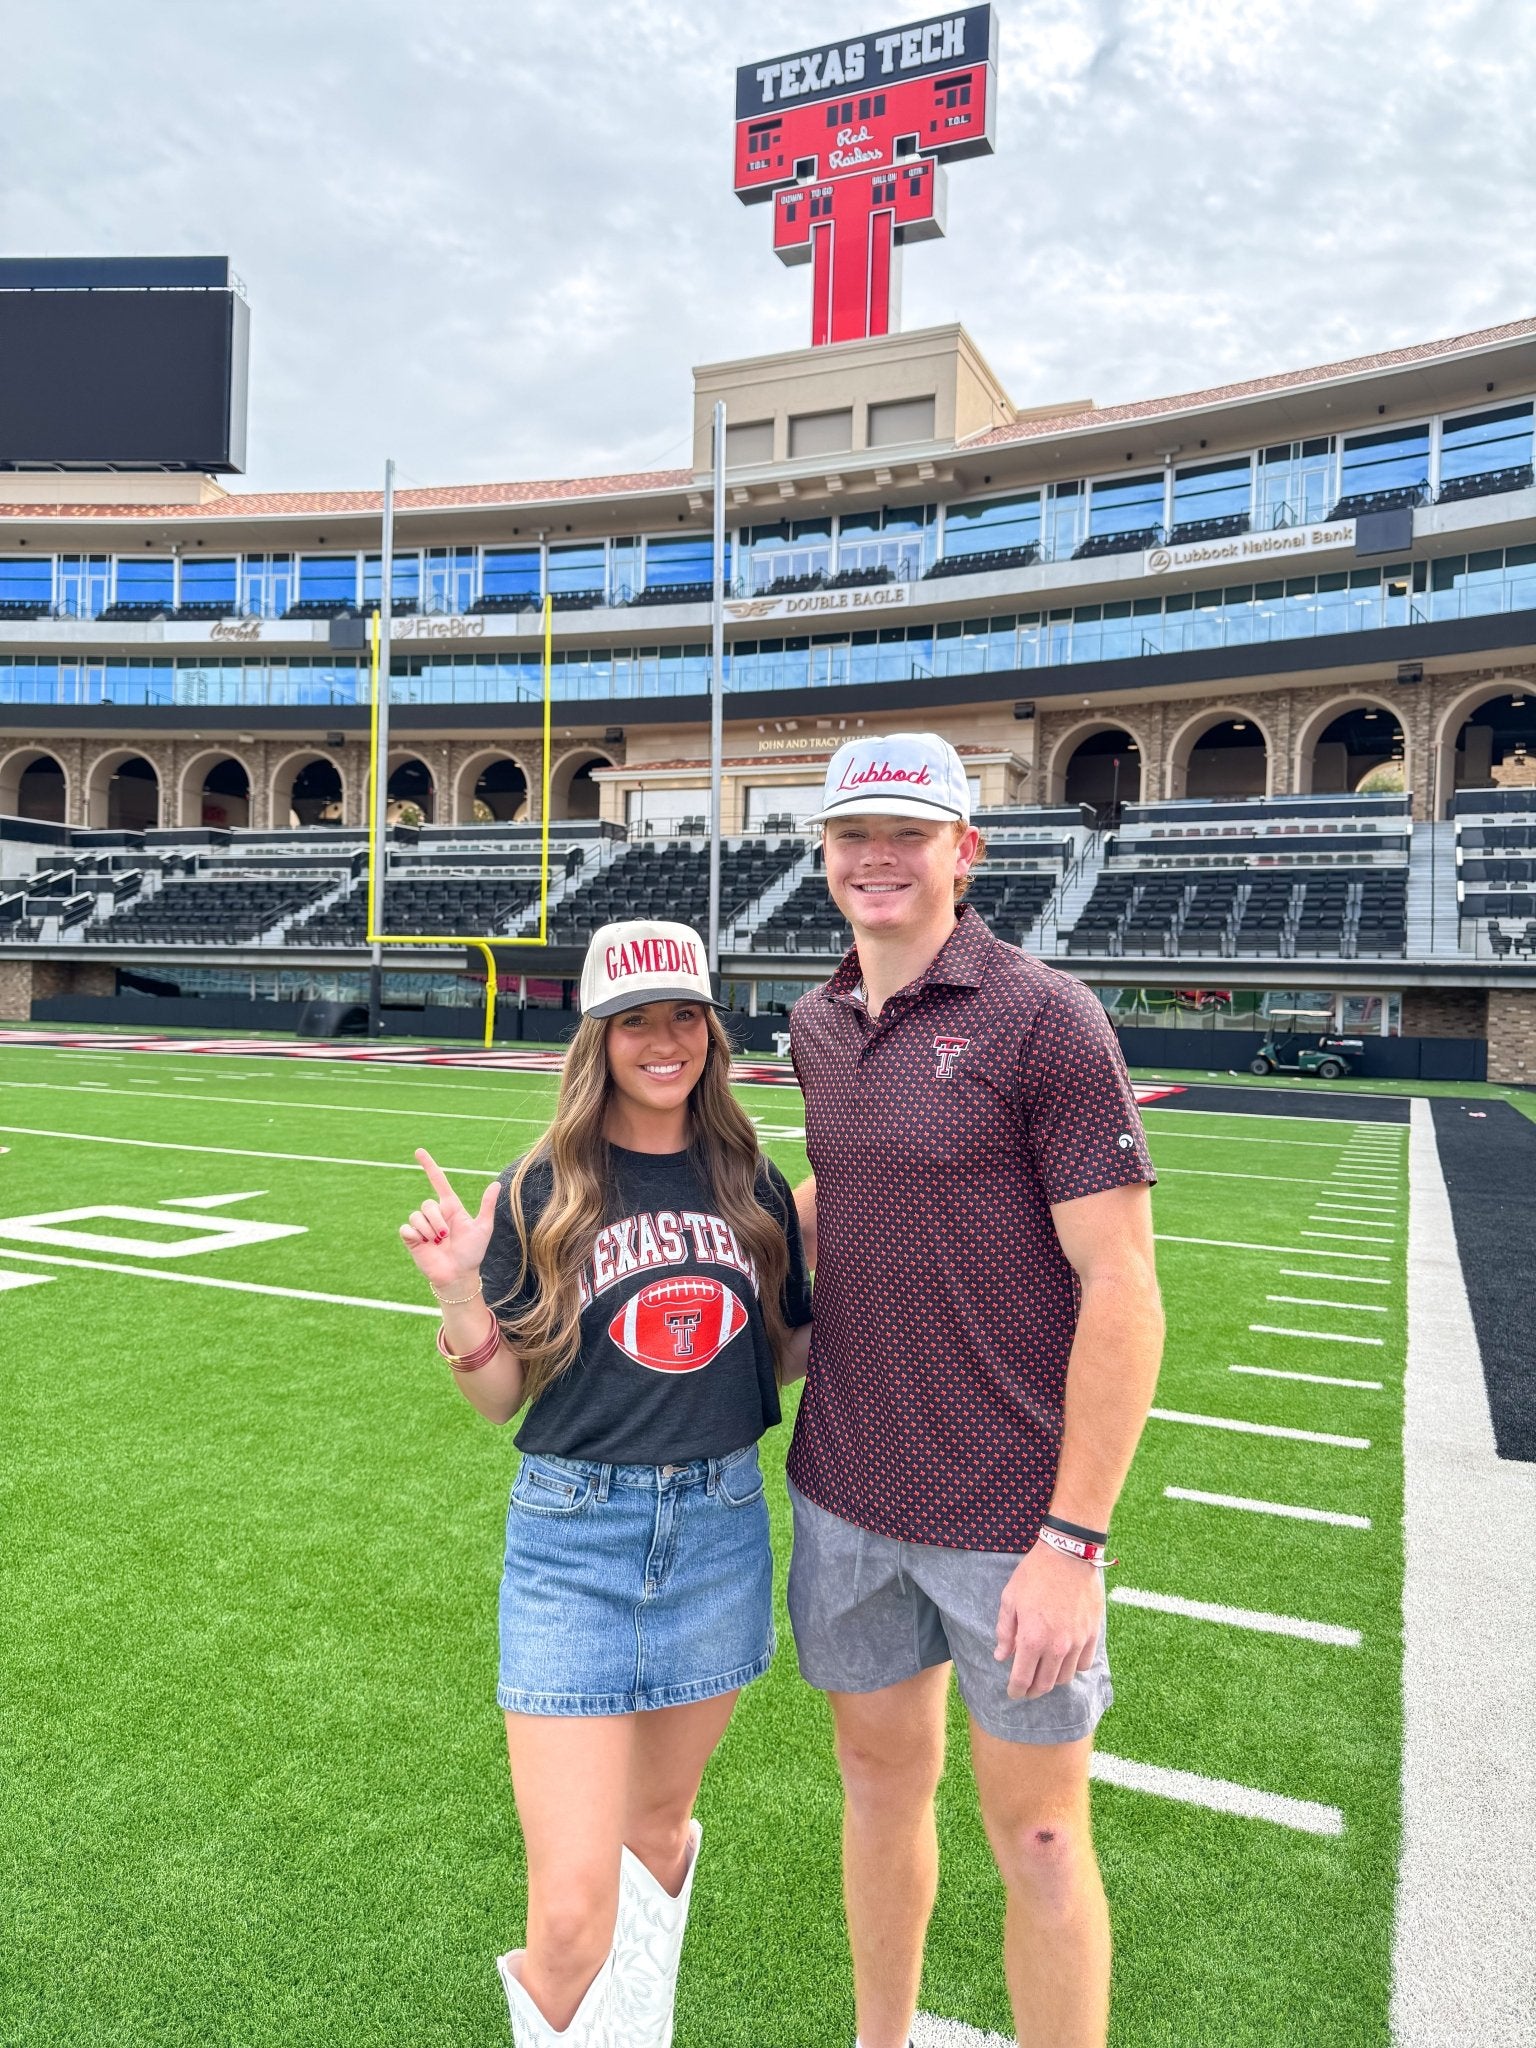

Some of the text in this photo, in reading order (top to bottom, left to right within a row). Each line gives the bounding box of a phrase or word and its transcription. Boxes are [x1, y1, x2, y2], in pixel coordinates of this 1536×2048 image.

[757, 17, 966, 103] TEXAS TECH
[837, 125, 875, 147] Red
[829, 147, 883, 169] Raiders
[780, 193, 804, 205] DOWN
[1174, 544, 1238, 565] Lubbock
[1242, 532, 1306, 554] National
[1312, 526, 1353, 545] Bank
[785, 588, 905, 612] DOUBLE EAGLE
[416, 616, 485, 638] FireBird
[758, 740, 784, 752] JOHN
[786, 738, 807, 749] AND
[810, 736, 841, 748] TRACY
[836, 757, 932, 792] Lubbock
[605, 938, 699, 981] GAMEDAY
[680, 1210, 760, 1301] TEC
